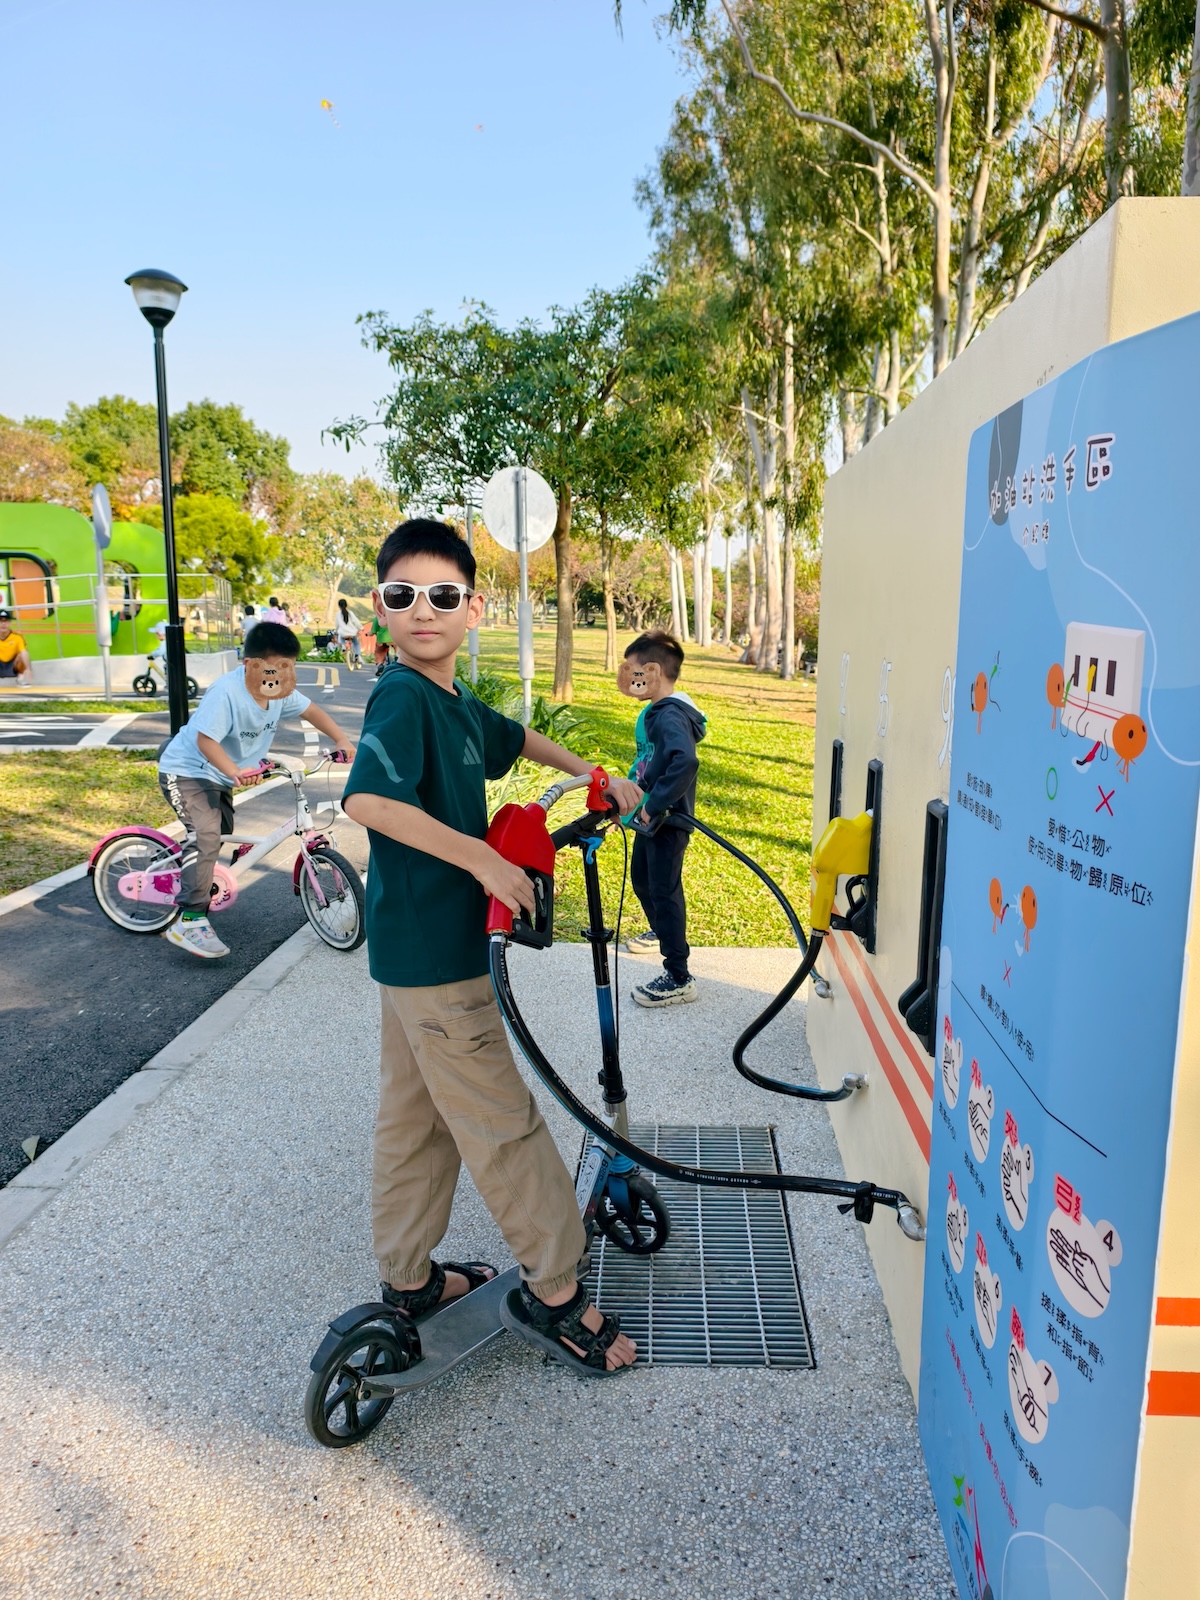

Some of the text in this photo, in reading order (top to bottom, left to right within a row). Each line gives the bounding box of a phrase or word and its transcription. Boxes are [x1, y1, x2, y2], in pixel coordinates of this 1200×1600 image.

[990, 435, 1114, 516] 加油站洗手區
[1048, 817, 1112, 858] 愛惜公物
[1028, 835, 1153, 906] 使用完畢物歸原位
[987, 1089, 993, 1109] 2
[1025, 1150, 1032, 1171] 3
[963, 1209, 968, 1227] 5
[1103, 1229, 1114, 1252] 4
[995, 1280, 1000, 1299] 6
[1041, 1291, 1105, 1366] 搓揉指背
[1047, 1321, 1094, 1383] 和指節
[1043, 1364, 1053, 1386] 7
